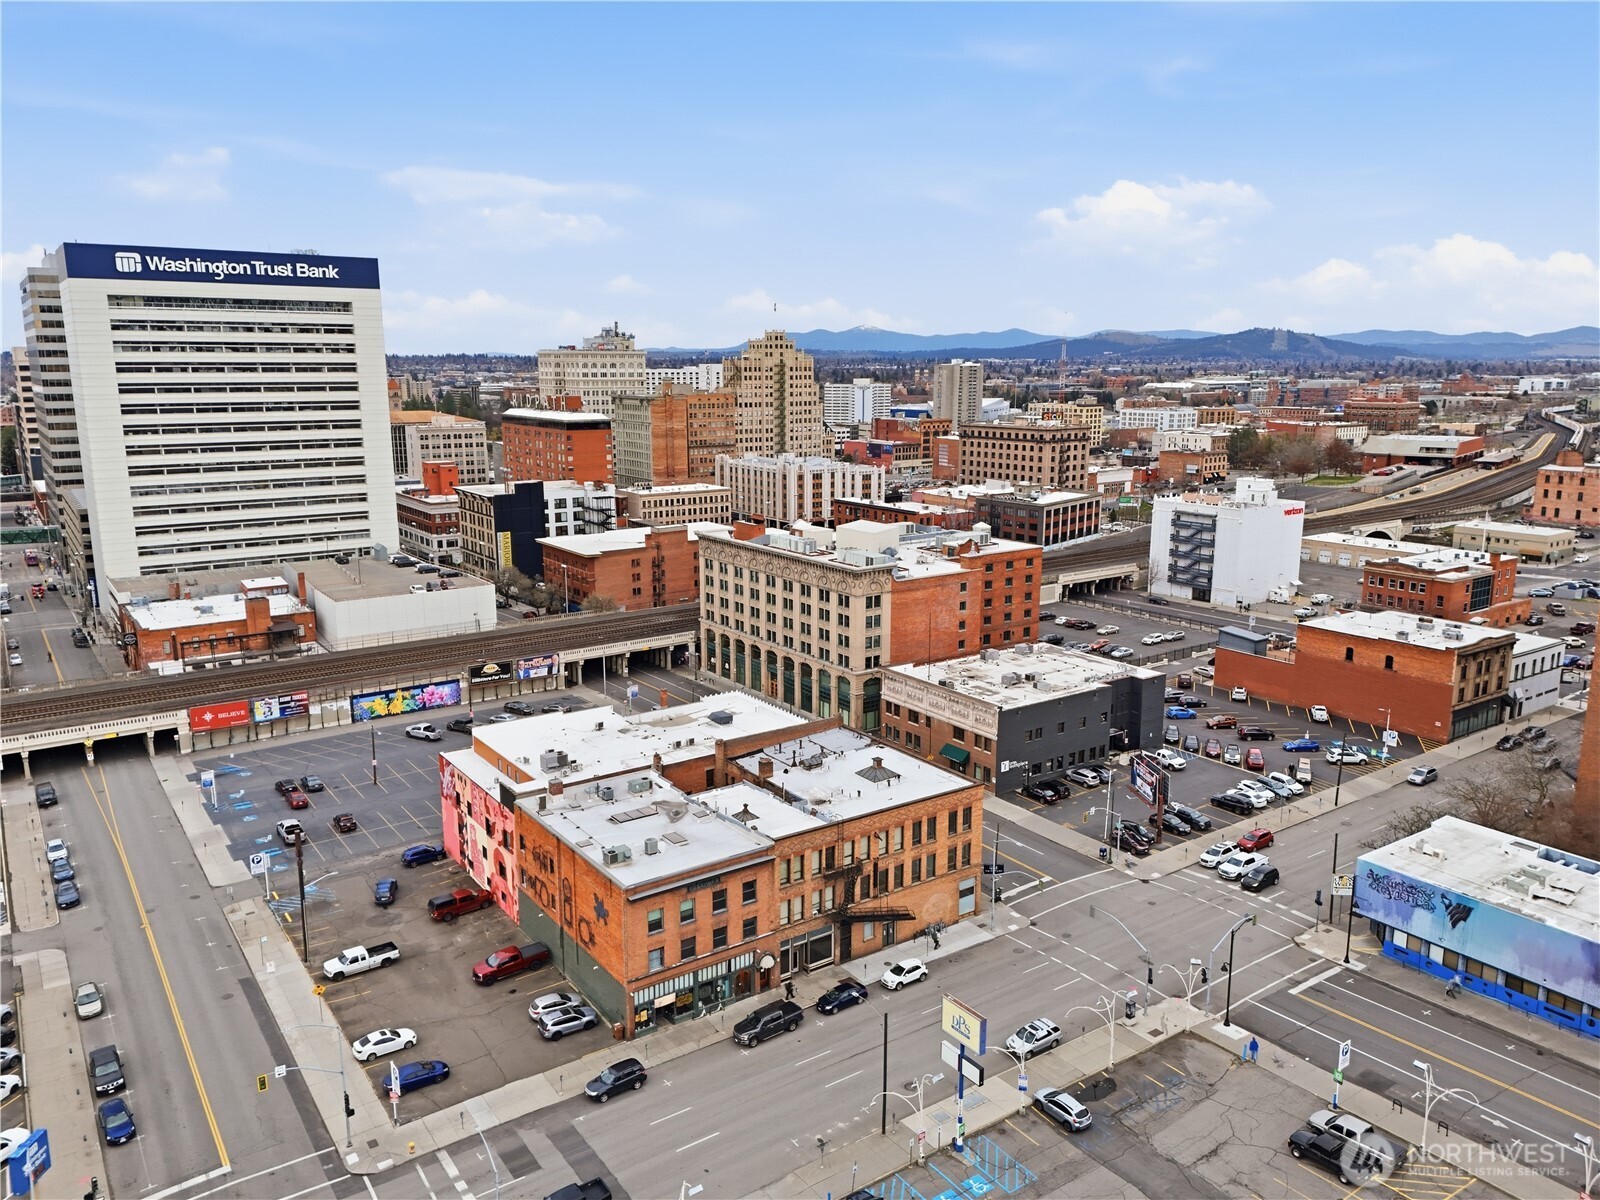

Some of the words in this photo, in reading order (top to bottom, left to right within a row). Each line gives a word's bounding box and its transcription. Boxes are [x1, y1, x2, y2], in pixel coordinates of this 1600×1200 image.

[144, 255, 250, 280] Washington
[251, 261, 293, 277] Trust
[296, 263, 340, 279] Bank
[510, 392, 566, 411] RIDPATH
[1284, 507, 1304, 516] verizon
[503, 532, 511, 568] MARJORI
[217, 710, 246, 719] BELIEVE
[952, 1014, 971, 1035] DPS
